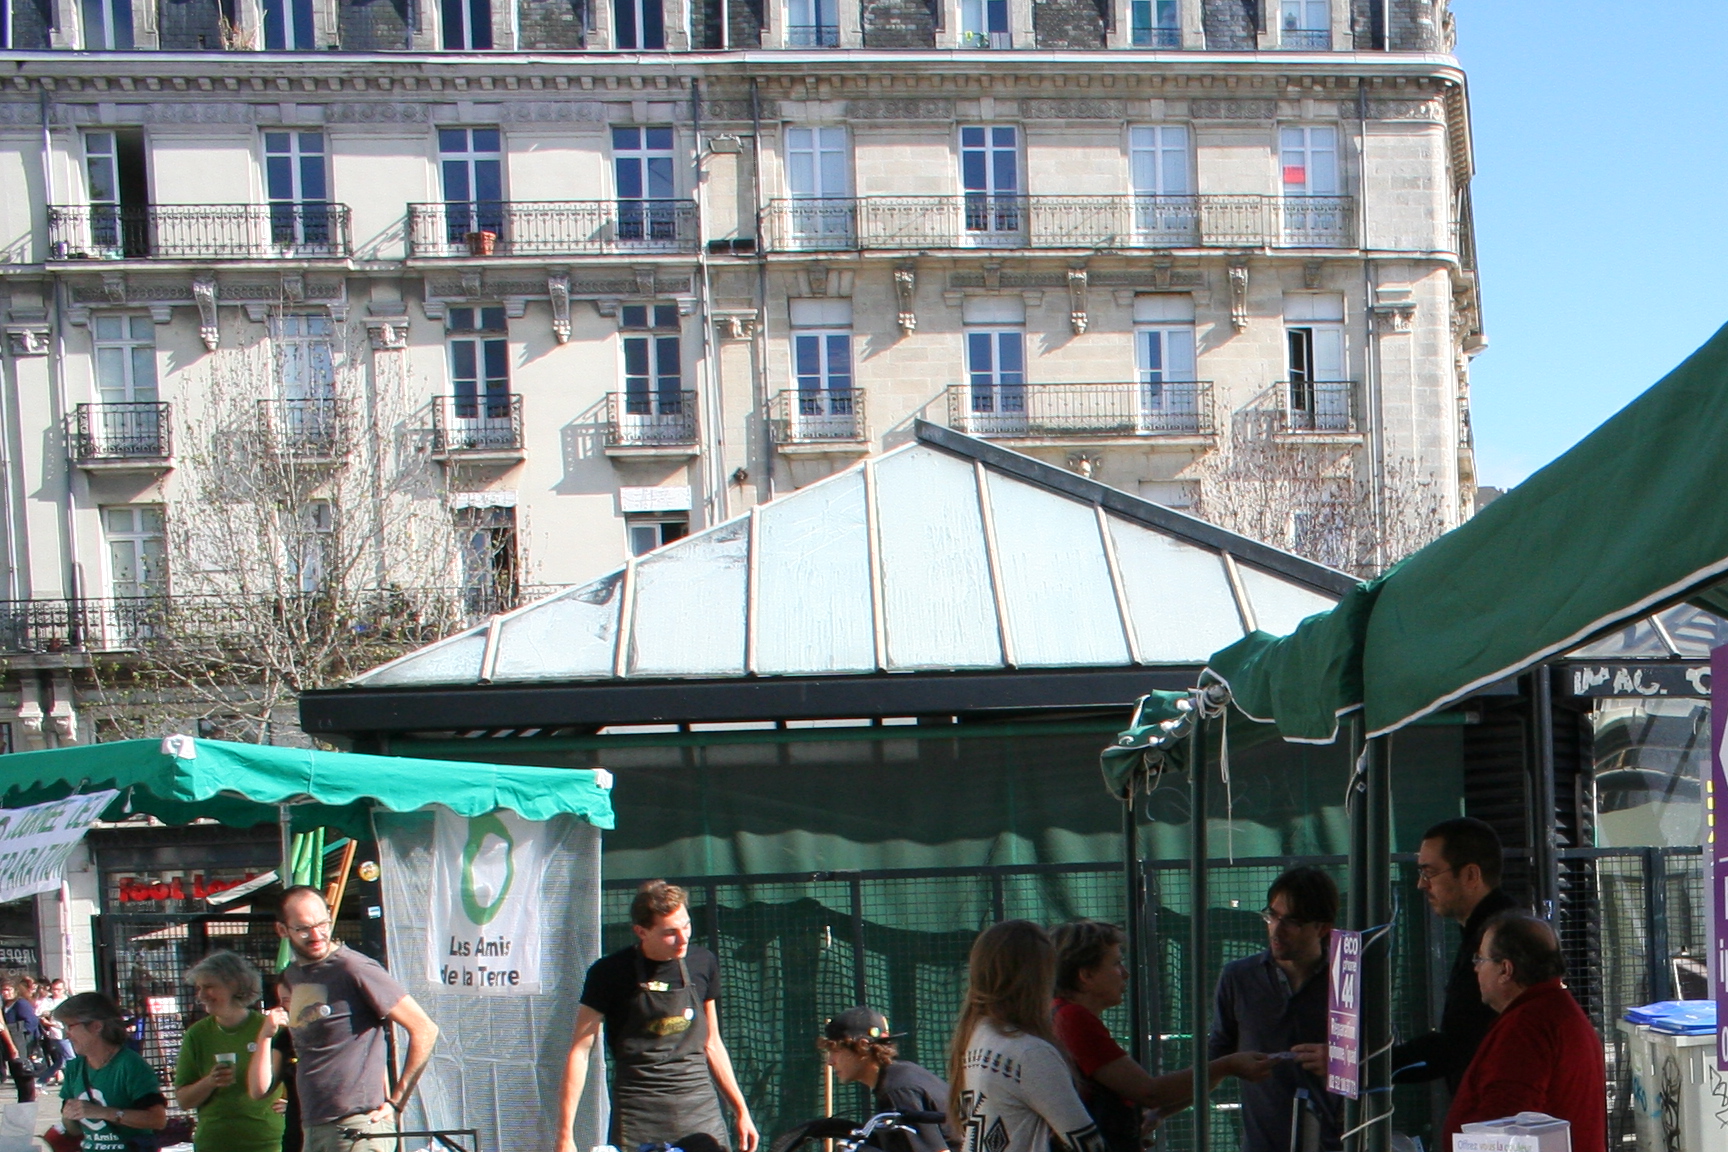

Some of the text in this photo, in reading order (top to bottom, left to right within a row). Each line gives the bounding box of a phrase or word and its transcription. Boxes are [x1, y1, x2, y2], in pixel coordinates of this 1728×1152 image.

[475, 935, 512, 957] Amis
[1343, 936, 1359, 956] eco
[440, 964, 520, 987] de la Terre
[1343, 958, 1357, 974] phone
[1341, 974, 1354, 1009] 44
[1496, 1141, 1503, 1151] la
